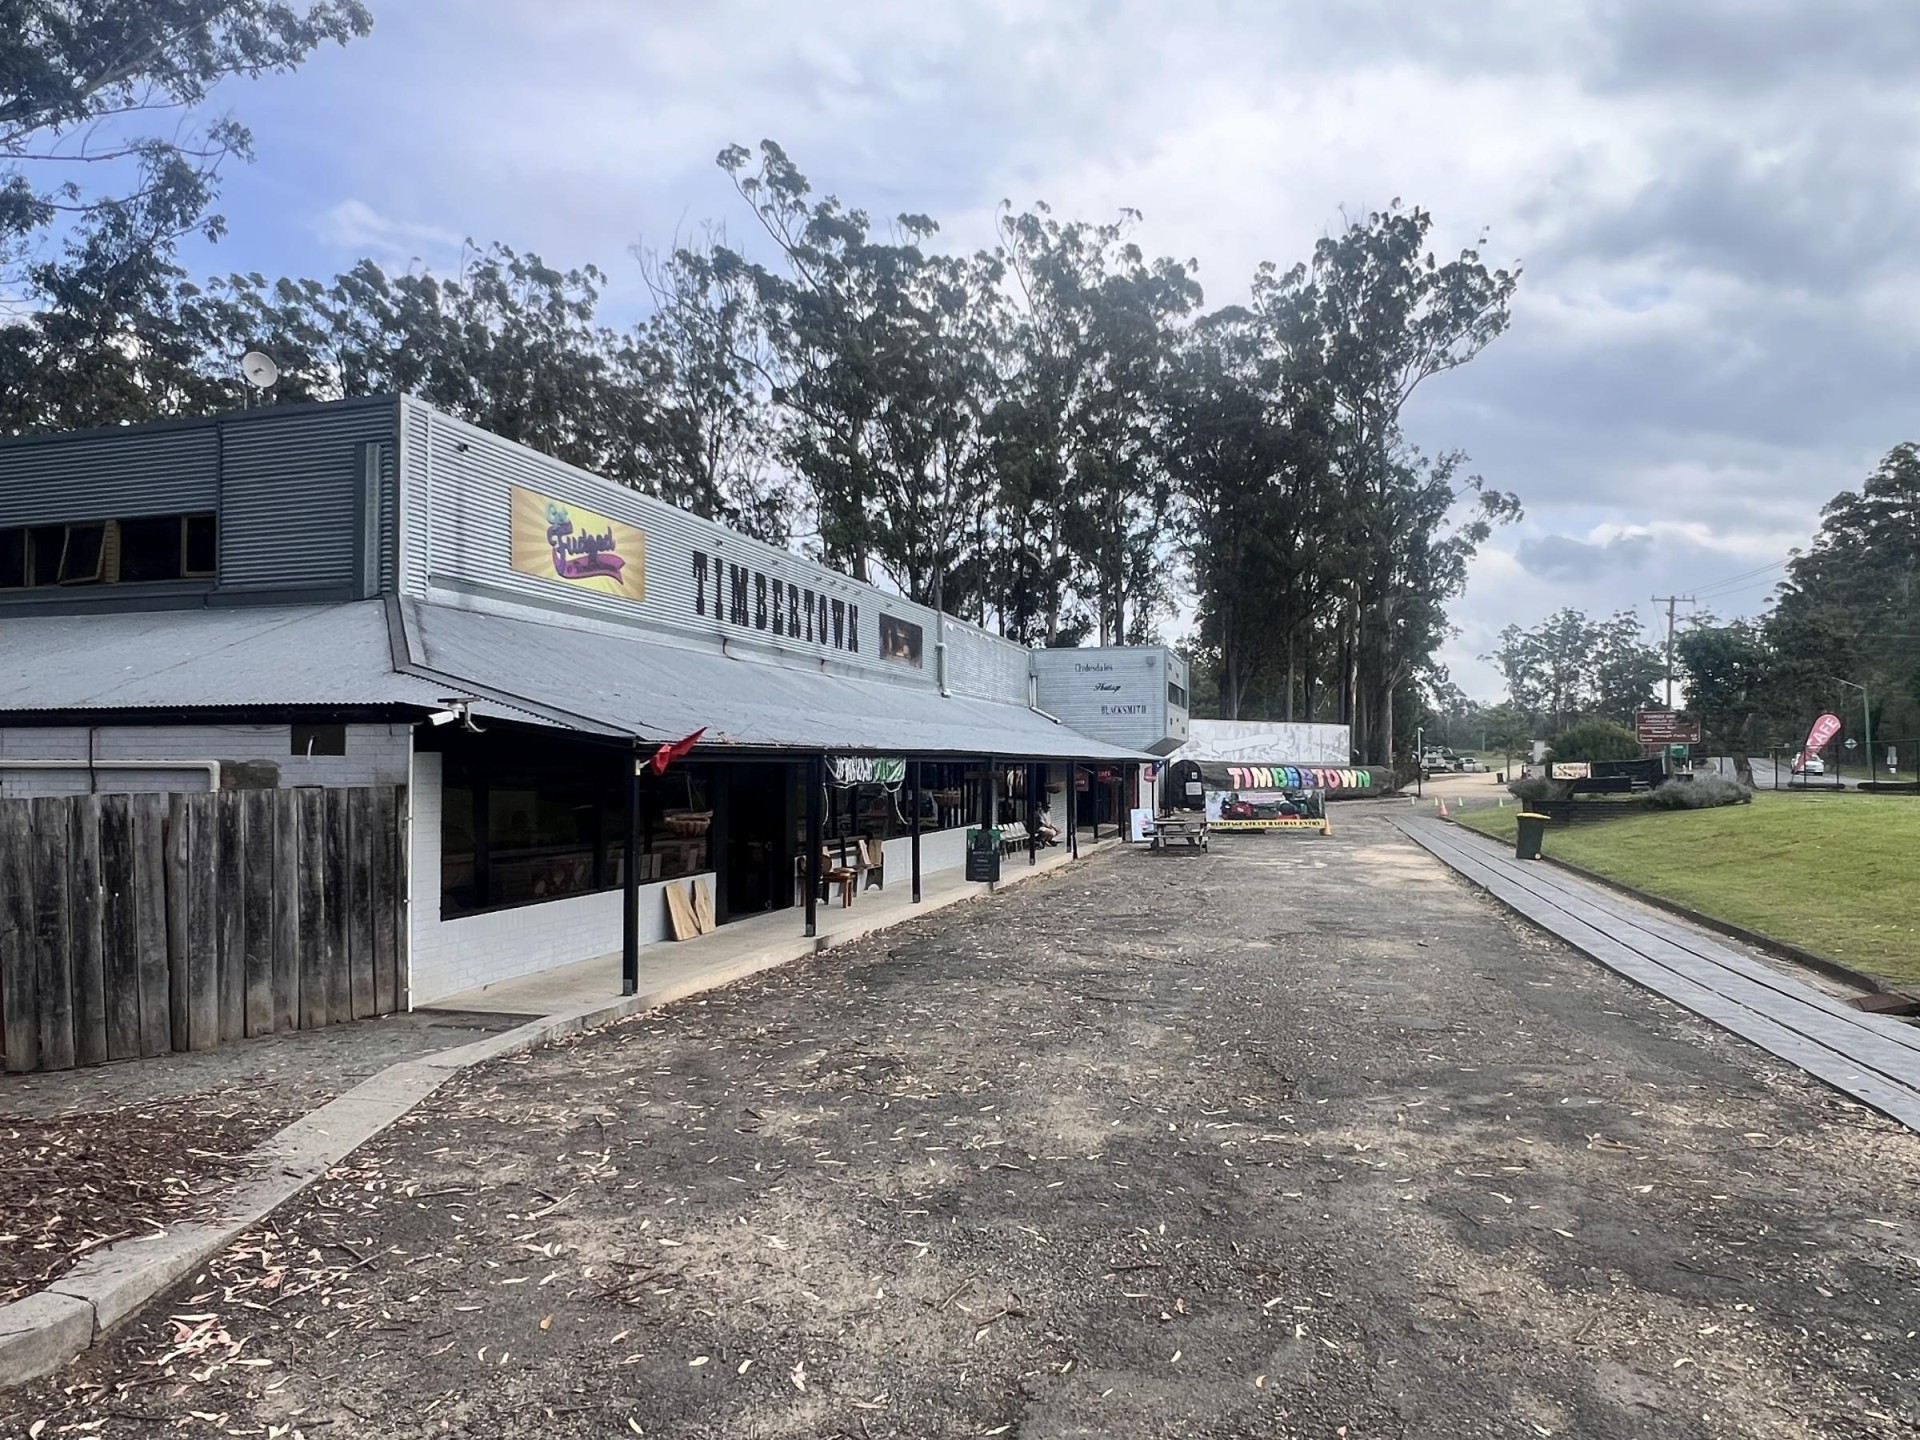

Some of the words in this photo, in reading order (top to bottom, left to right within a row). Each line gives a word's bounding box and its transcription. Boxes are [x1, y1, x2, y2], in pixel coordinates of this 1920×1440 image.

[692, 549, 860, 654] TIMBERTOWN
[1100, 704, 1147, 715] BLACKSMITH
[1226, 766, 1373, 790] TIMBERTOWN
